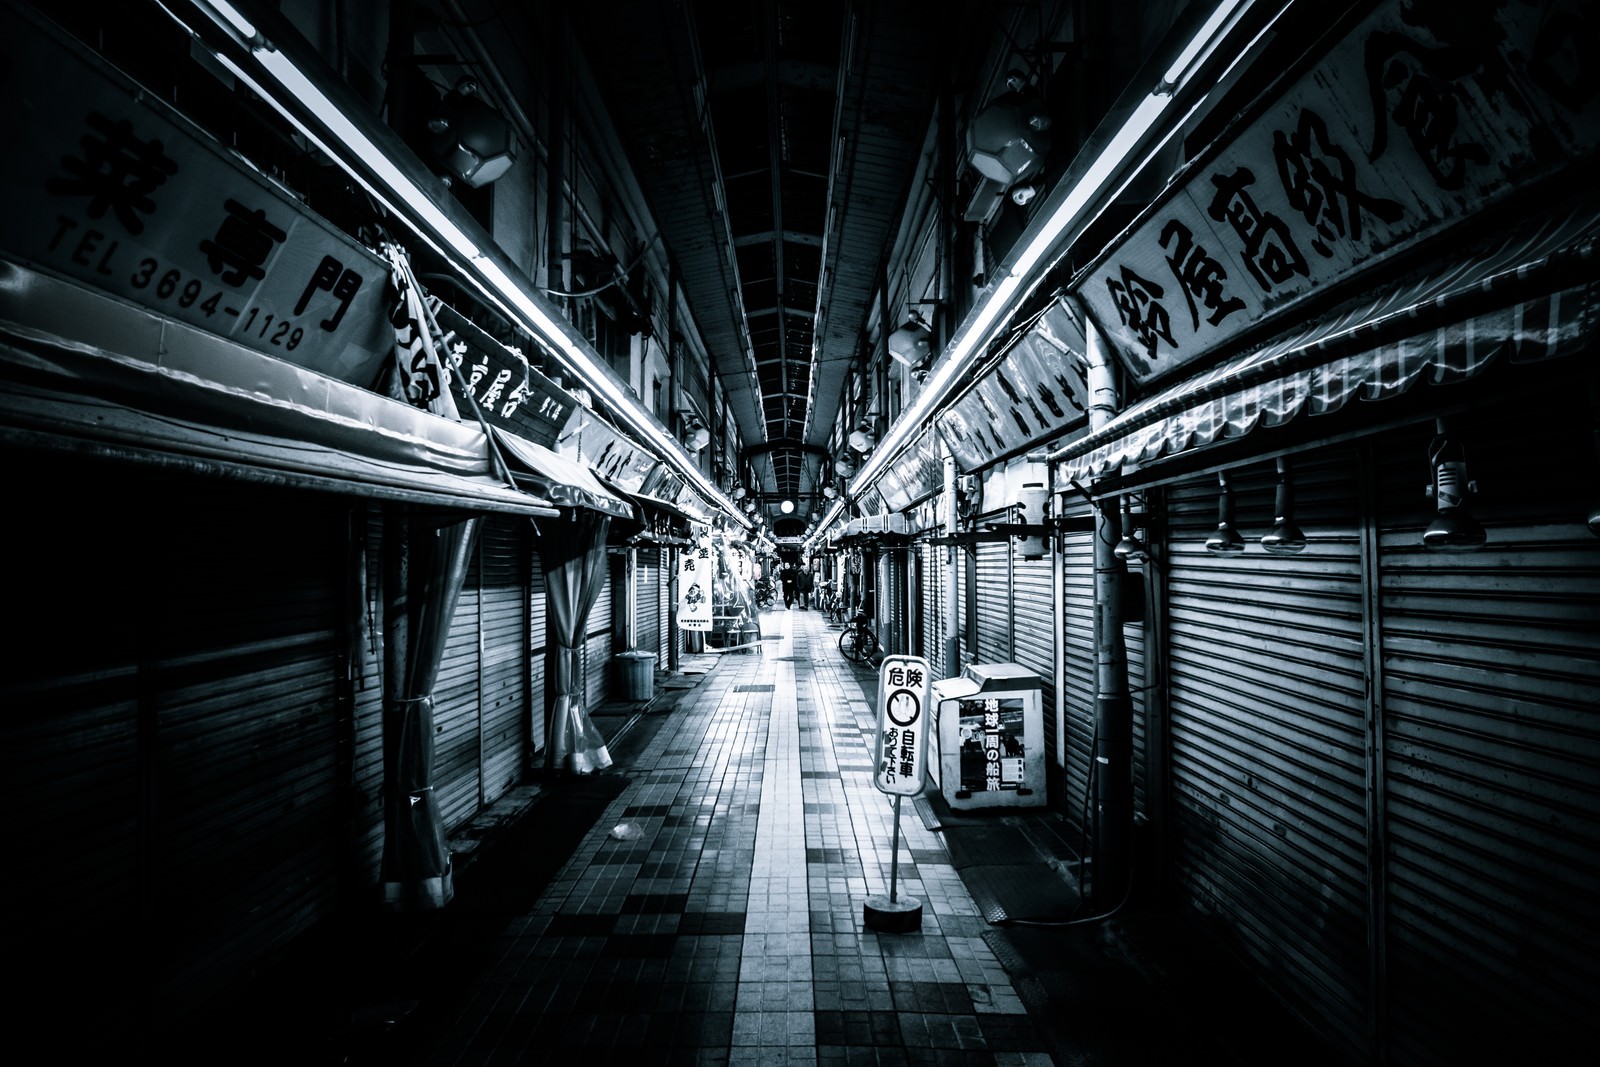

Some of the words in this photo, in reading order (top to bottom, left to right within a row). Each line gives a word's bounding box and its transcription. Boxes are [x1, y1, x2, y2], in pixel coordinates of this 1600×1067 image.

[48, 215, 118, 276] TEL
[130, 257, 304, 352] 3694-1129
[888, 667, 923, 688] 危険
[899, 729, 915, 778] 自転車
[984, 698, 1000, 791] 地球一周の船旅
